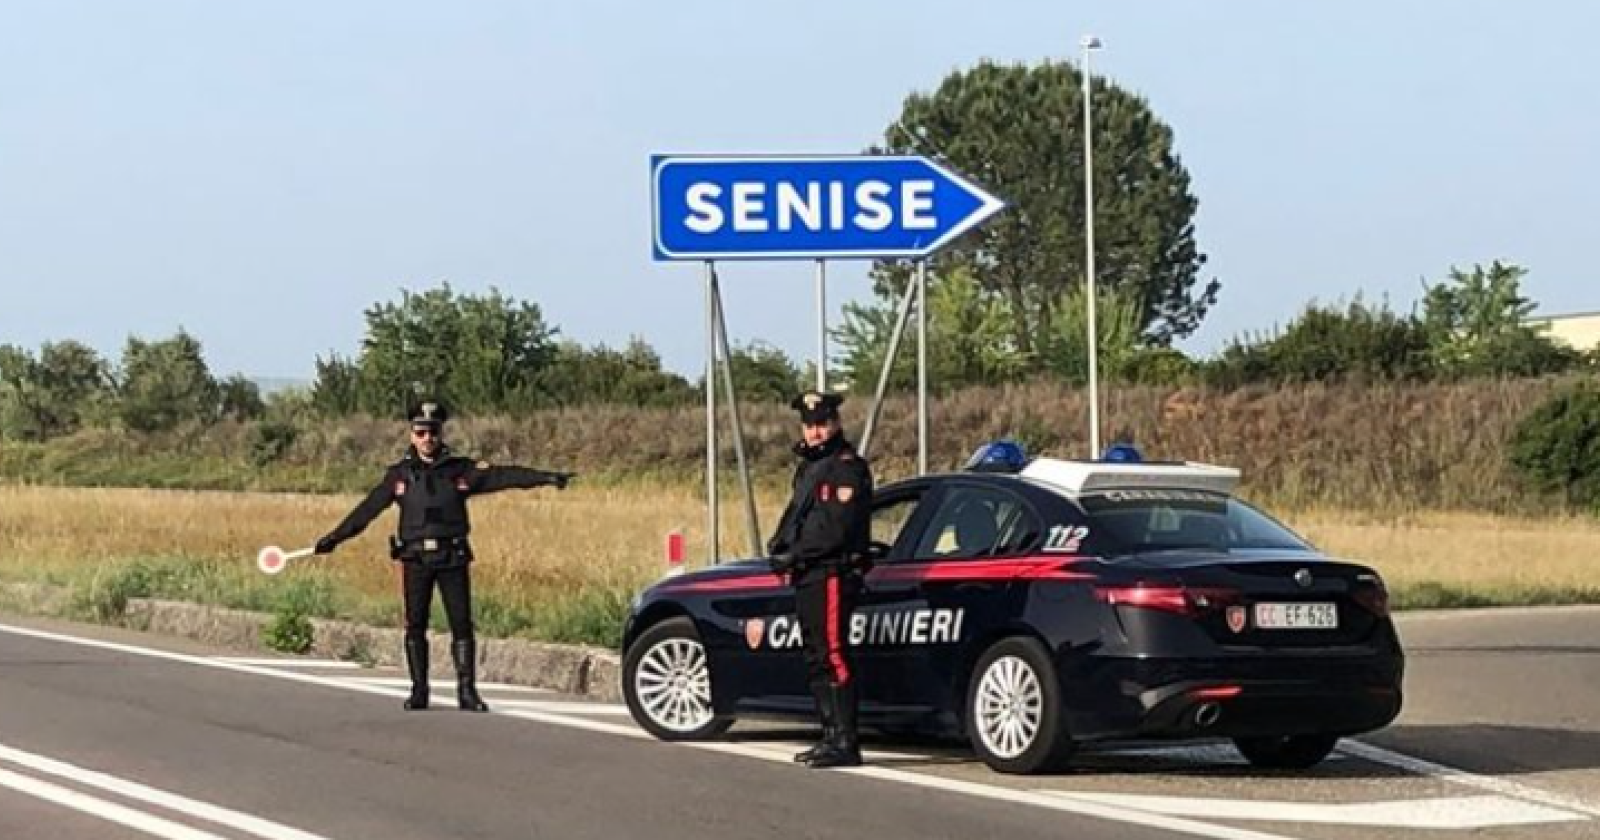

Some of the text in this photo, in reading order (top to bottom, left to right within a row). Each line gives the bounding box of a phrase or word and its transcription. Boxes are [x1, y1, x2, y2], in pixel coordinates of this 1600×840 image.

[683, 179, 938, 234] SENISE
[1045, 525, 1090, 548] 112
[768, 607, 965, 649] CABINIERI
